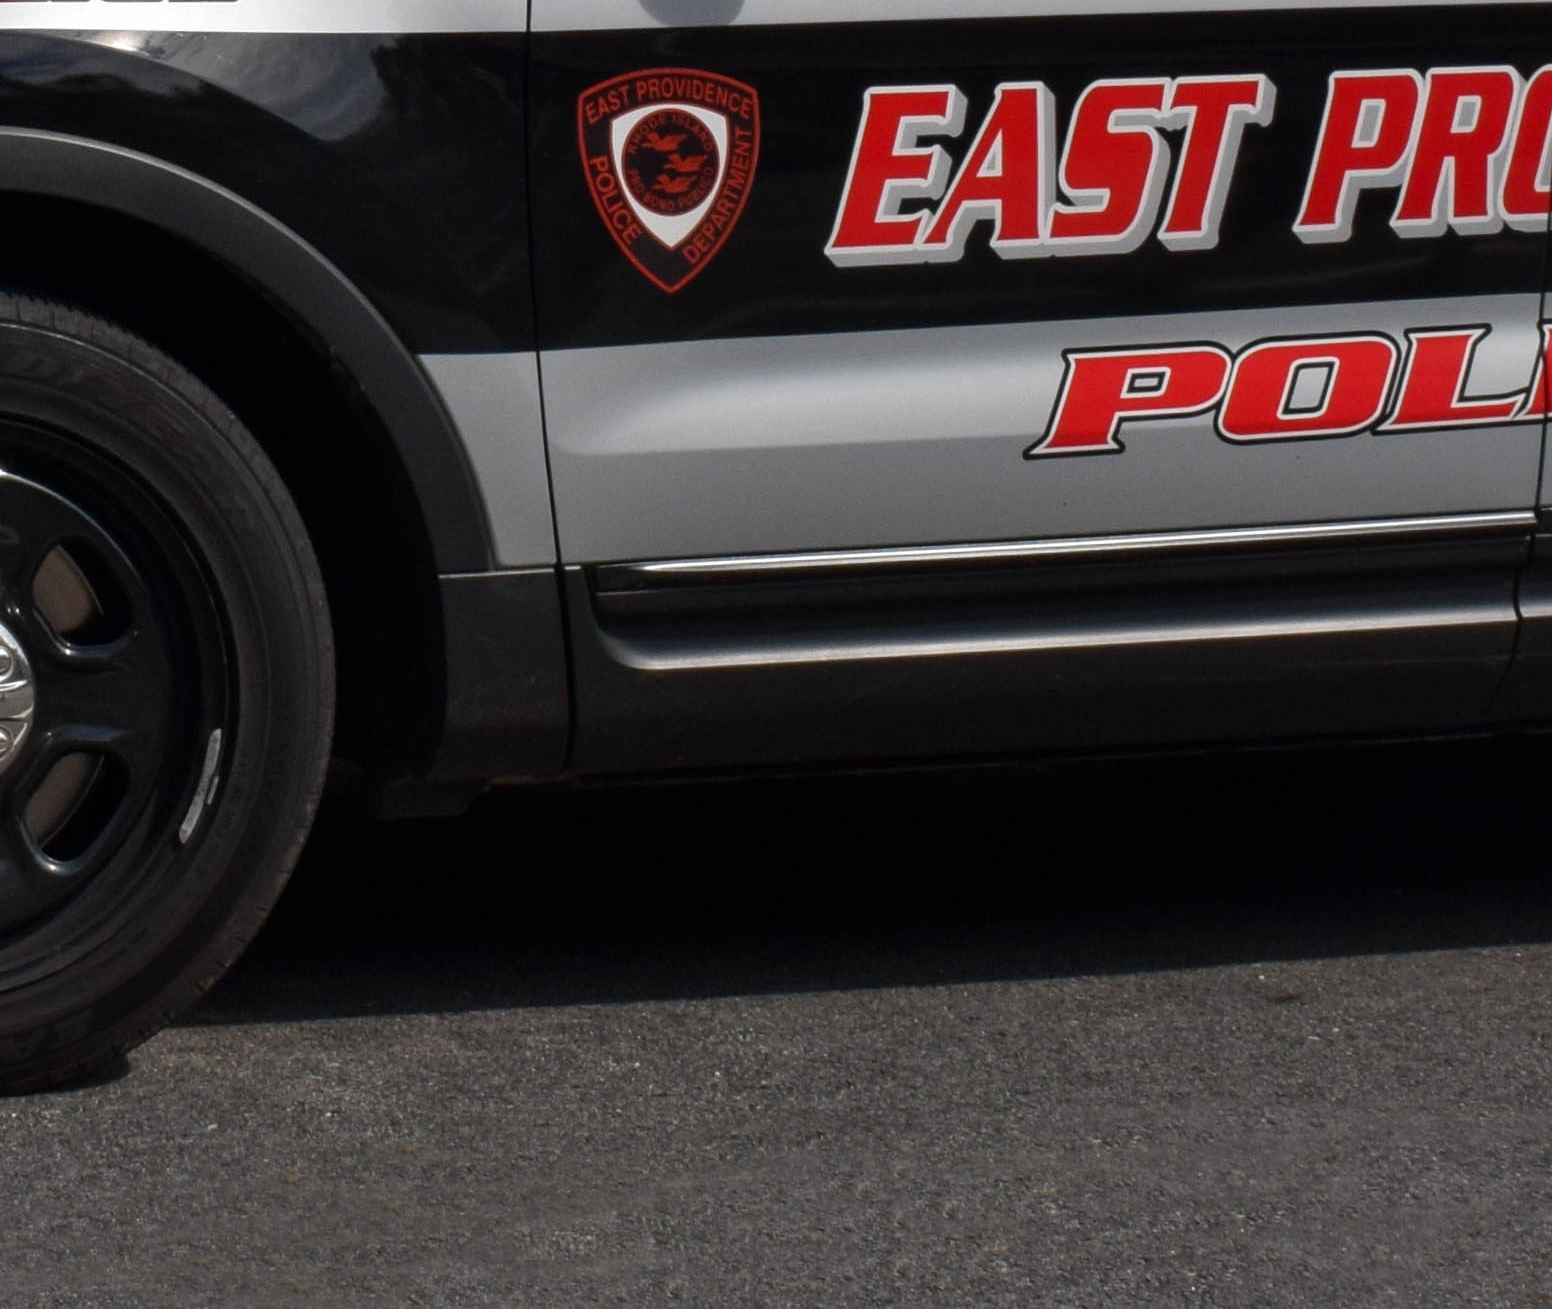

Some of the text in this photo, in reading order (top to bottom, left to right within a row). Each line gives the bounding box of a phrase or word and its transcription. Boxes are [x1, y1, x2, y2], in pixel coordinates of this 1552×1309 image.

[584, 76, 754, 125] EAST PROVIDENCE
[627, 114, 666, 155] RHODE
[589, 154, 643, 245] POLICE
[680, 126, 753, 265] DEPARTMENT
[824, 74, 1276, 268] EAST
